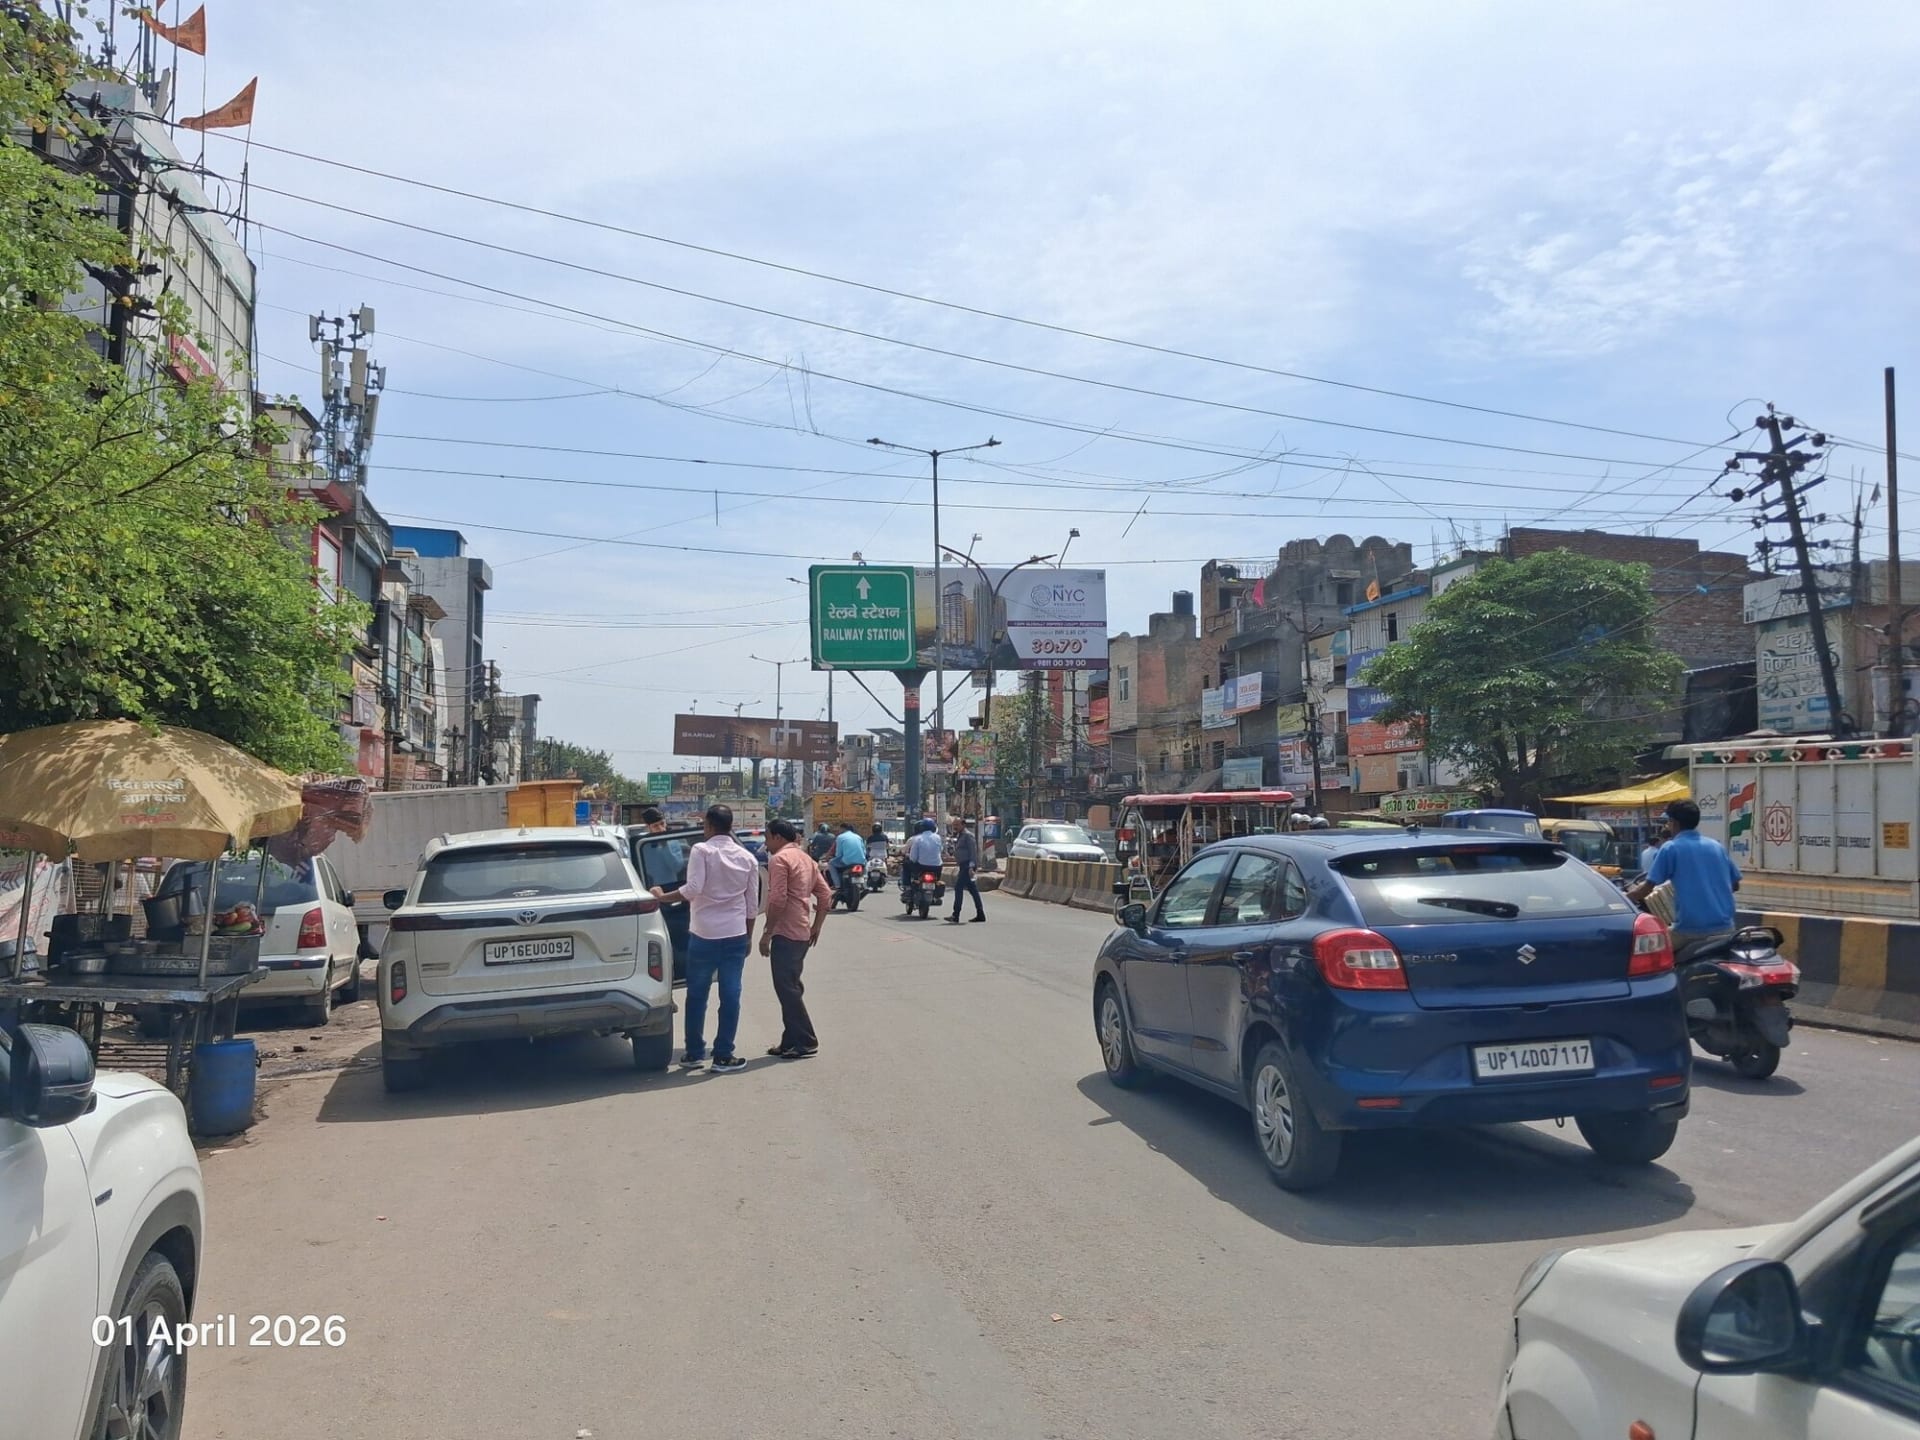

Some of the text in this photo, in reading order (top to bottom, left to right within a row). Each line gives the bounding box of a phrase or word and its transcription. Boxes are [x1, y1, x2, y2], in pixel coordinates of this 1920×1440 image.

[1052, 589, 1085, 602] NYC
[828, 602, 901, 619] रेलवे स्टेशन
[823, 628, 906, 641] RAILWAY STATION
[1052, 659, 1064, 667] 00
[1075, 659, 1087, 667] 00
[1406, 799, 1416, 811] 20
[493, 941, 571, 959] UP16EU0092
[1412, 953, 1458, 963] BALENO
